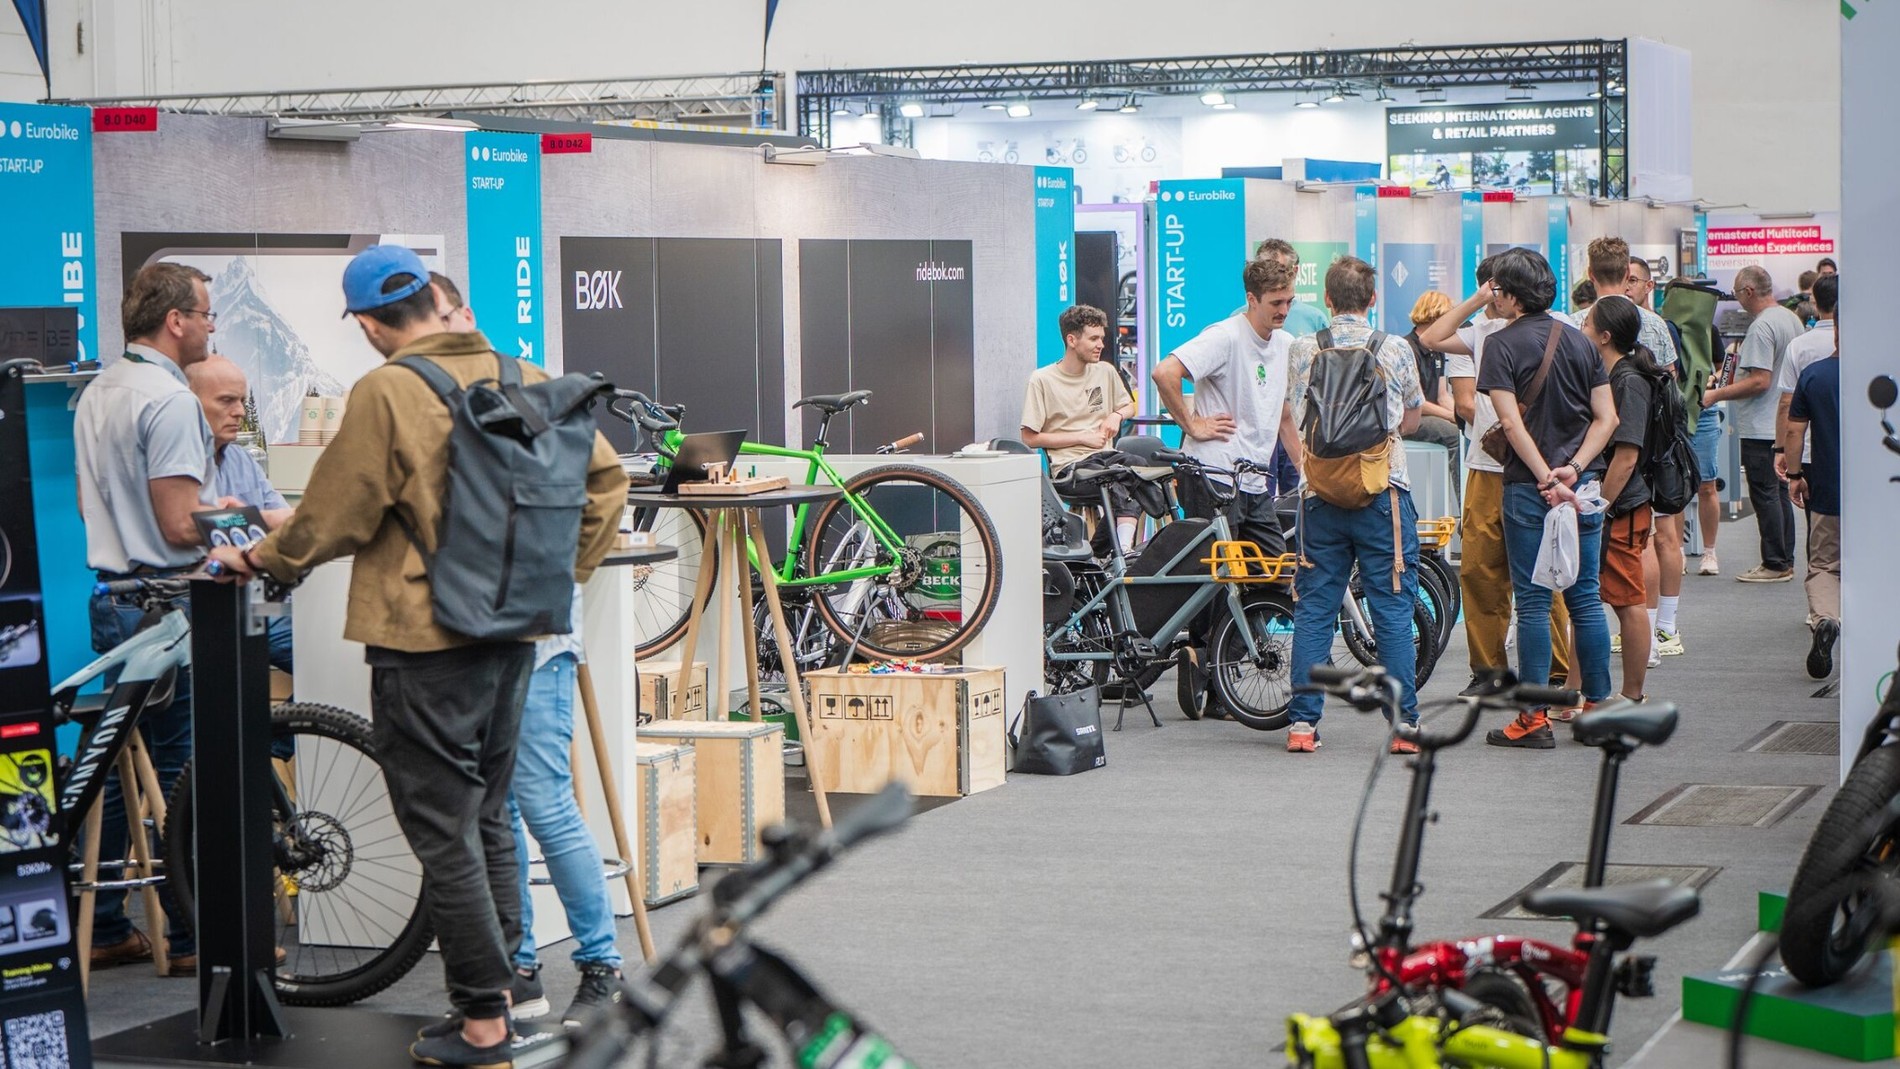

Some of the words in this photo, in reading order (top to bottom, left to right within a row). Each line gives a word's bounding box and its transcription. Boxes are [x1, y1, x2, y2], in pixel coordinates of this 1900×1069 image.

[104, 114, 121, 126] 8.0
[124, 114, 147, 126] D40
[1389, 111, 1444, 125] SEEKING
[1445, 107, 1542, 123] INTERNATIONAL
[1544, 106, 1594, 119] AGENTS
[26, 122, 79, 140] Eurobike
[1431, 128, 1443, 140] &
[1445, 126, 1488, 139] RETAIL
[1490, 124, 1556, 138] PARTNERS
[565, 139, 583, 149] D42
[492, 148, 528, 163] Eurobike
[472, 177, 504, 190] START-UP
[1188, 190, 1236, 201] Eurobike
[1707, 229, 1765, 241] emastered
[1766, 227, 1819, 239] Multitools
[1707, 244, 1719, 255] or
[1720, 242, 1765, 254] Ultimate
[1766, 242, 1832, 255] Experiences
[916, 261, 965, 281] ridebok.com
[1165, 214, 1186, 328] START-UP
[516, 236, 532, 324] RIDE
[575, 270, 624, 309] BØK
[61, 705, 131, 810] CANYON
